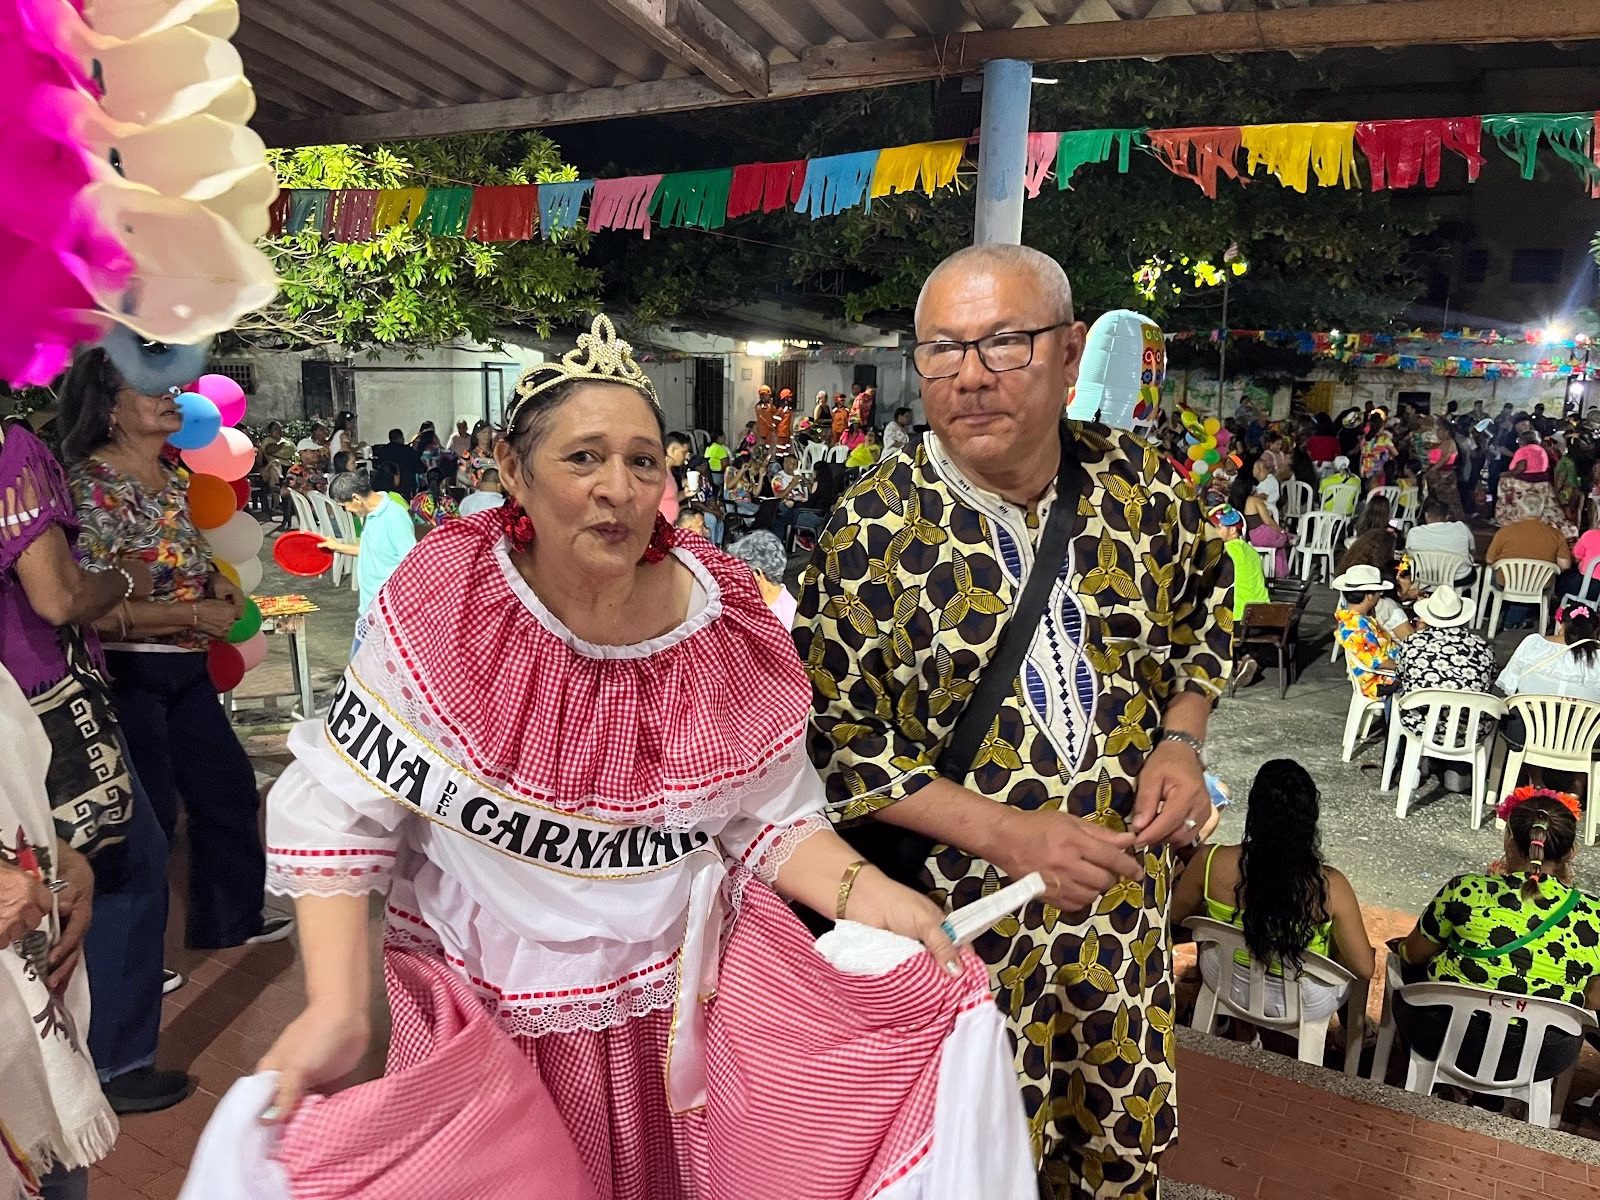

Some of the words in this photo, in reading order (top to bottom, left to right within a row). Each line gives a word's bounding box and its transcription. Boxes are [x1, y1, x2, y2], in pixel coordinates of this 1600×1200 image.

[327, 674, 431, 807] REINA
[435, 780, 458, 817] DEL
[460, 796, 709, 869] CARNAVAL
